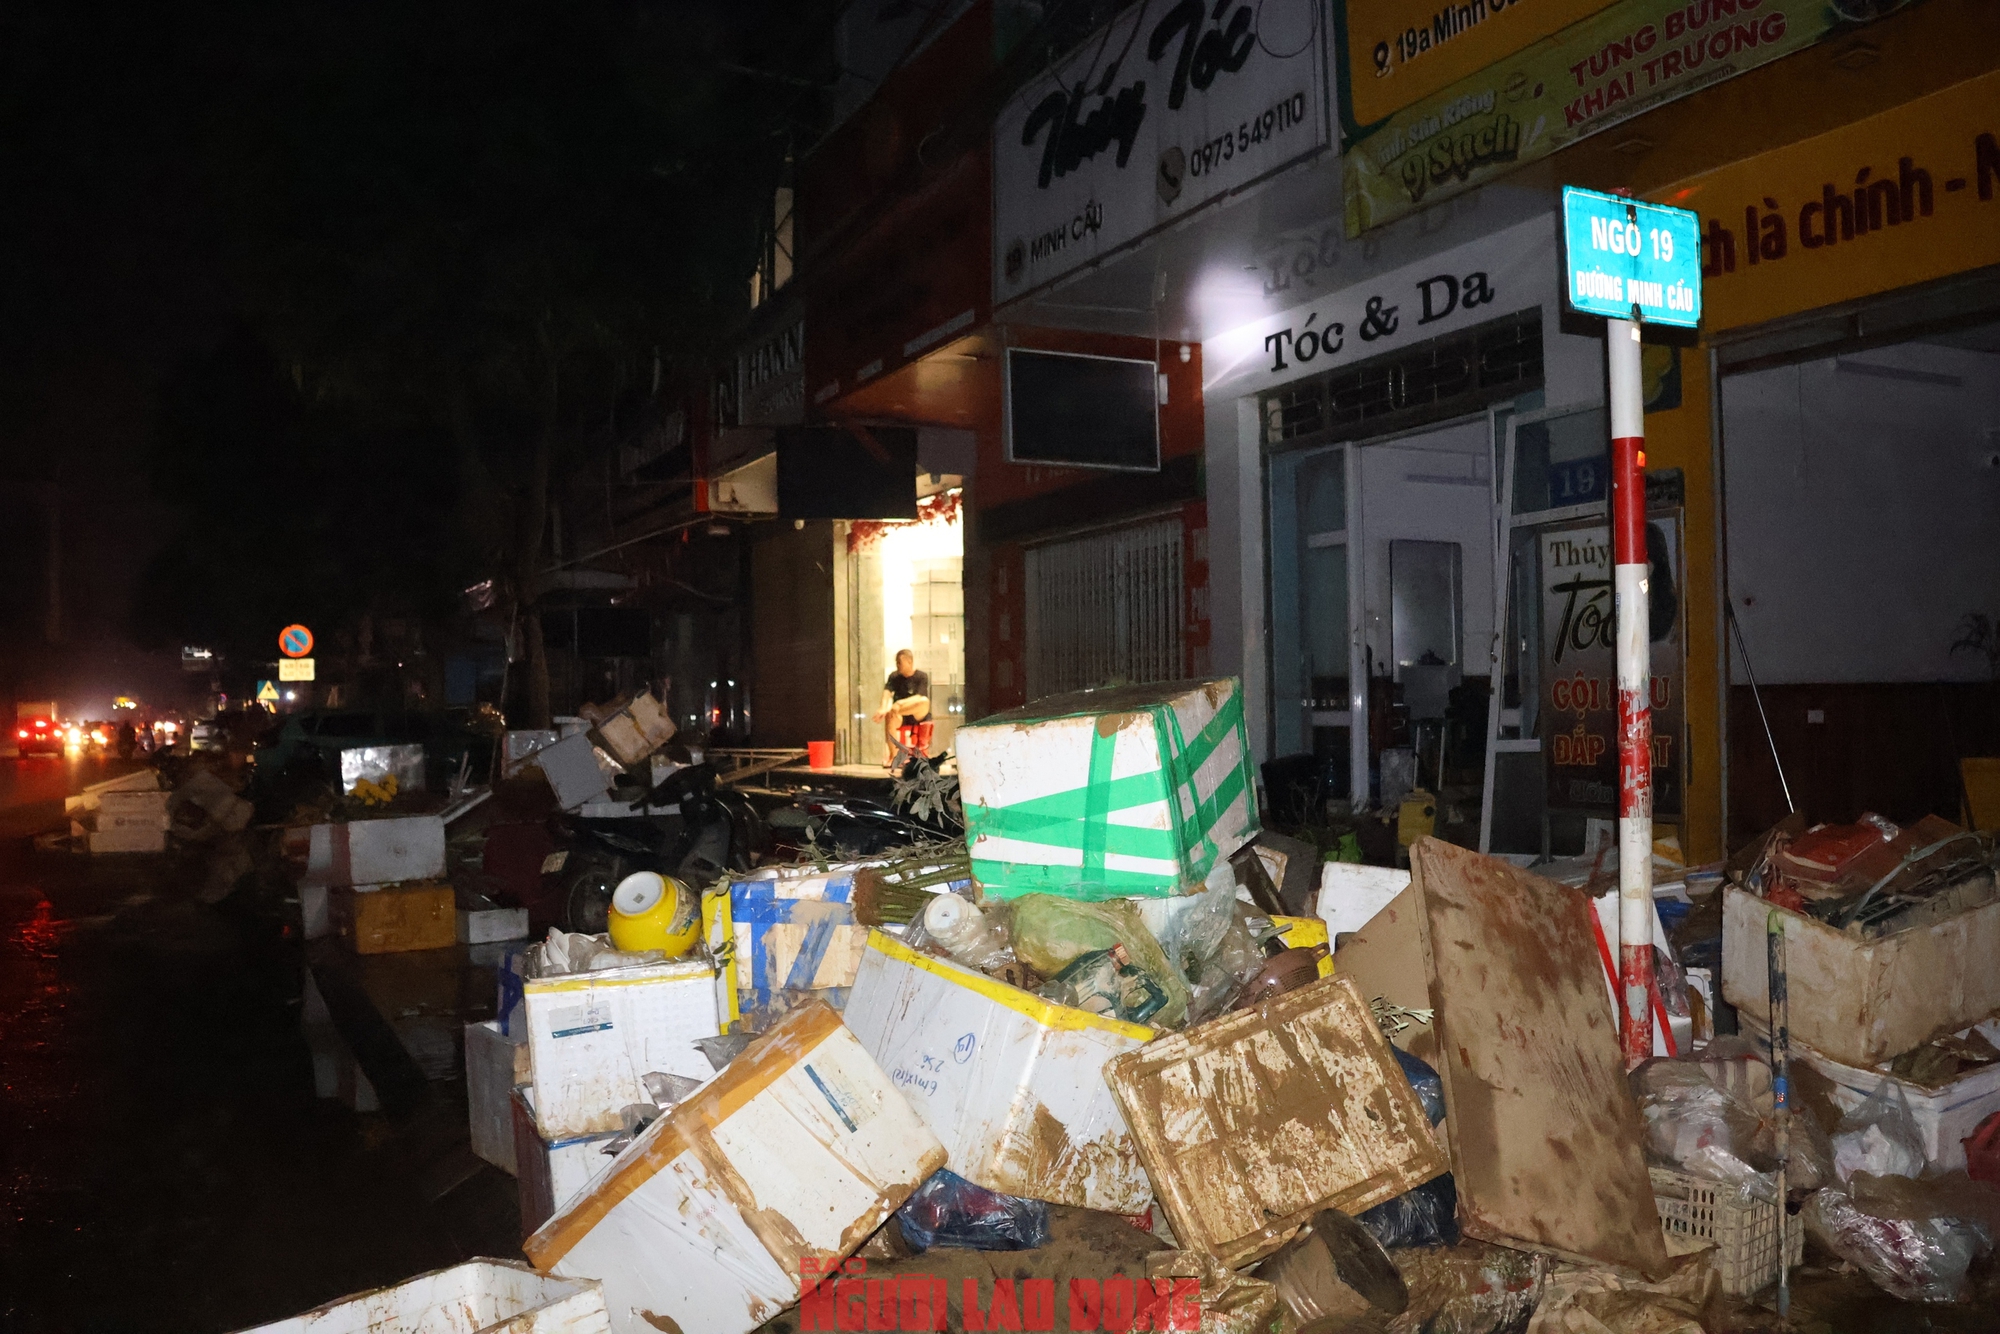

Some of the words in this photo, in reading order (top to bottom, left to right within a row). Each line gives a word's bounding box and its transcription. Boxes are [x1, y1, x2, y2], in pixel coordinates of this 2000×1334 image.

[1395, 27, 1432, 63] 19a
[1563, 70, 1636, 129] KHAI
[1190, 131, 1237, 178] 0973
[1238, 92, 1305, 152] 549110
[1745, 196, 1788, 265] là
[1799, 156, 1934, 249] chính
[1030, 223, 1067, 264] MINH
[1650, 227, 1674, 263] 19
[1576, 264, 1623, 302] ĐƯỜNG
[1626, 278, 1663, 308] MINH
[1265, 312, 1345, 373] Tóc
[1359, 296, 1399, 342] &
[1415, 271, 1495, 326] Da
[1559, 467, 1595, 498] 19
[1549, 538, 1611, 569] Thúy
[1552, 670, 1601, 720] GỘI
[1553, 723, 1606, 766] ĐẮP
